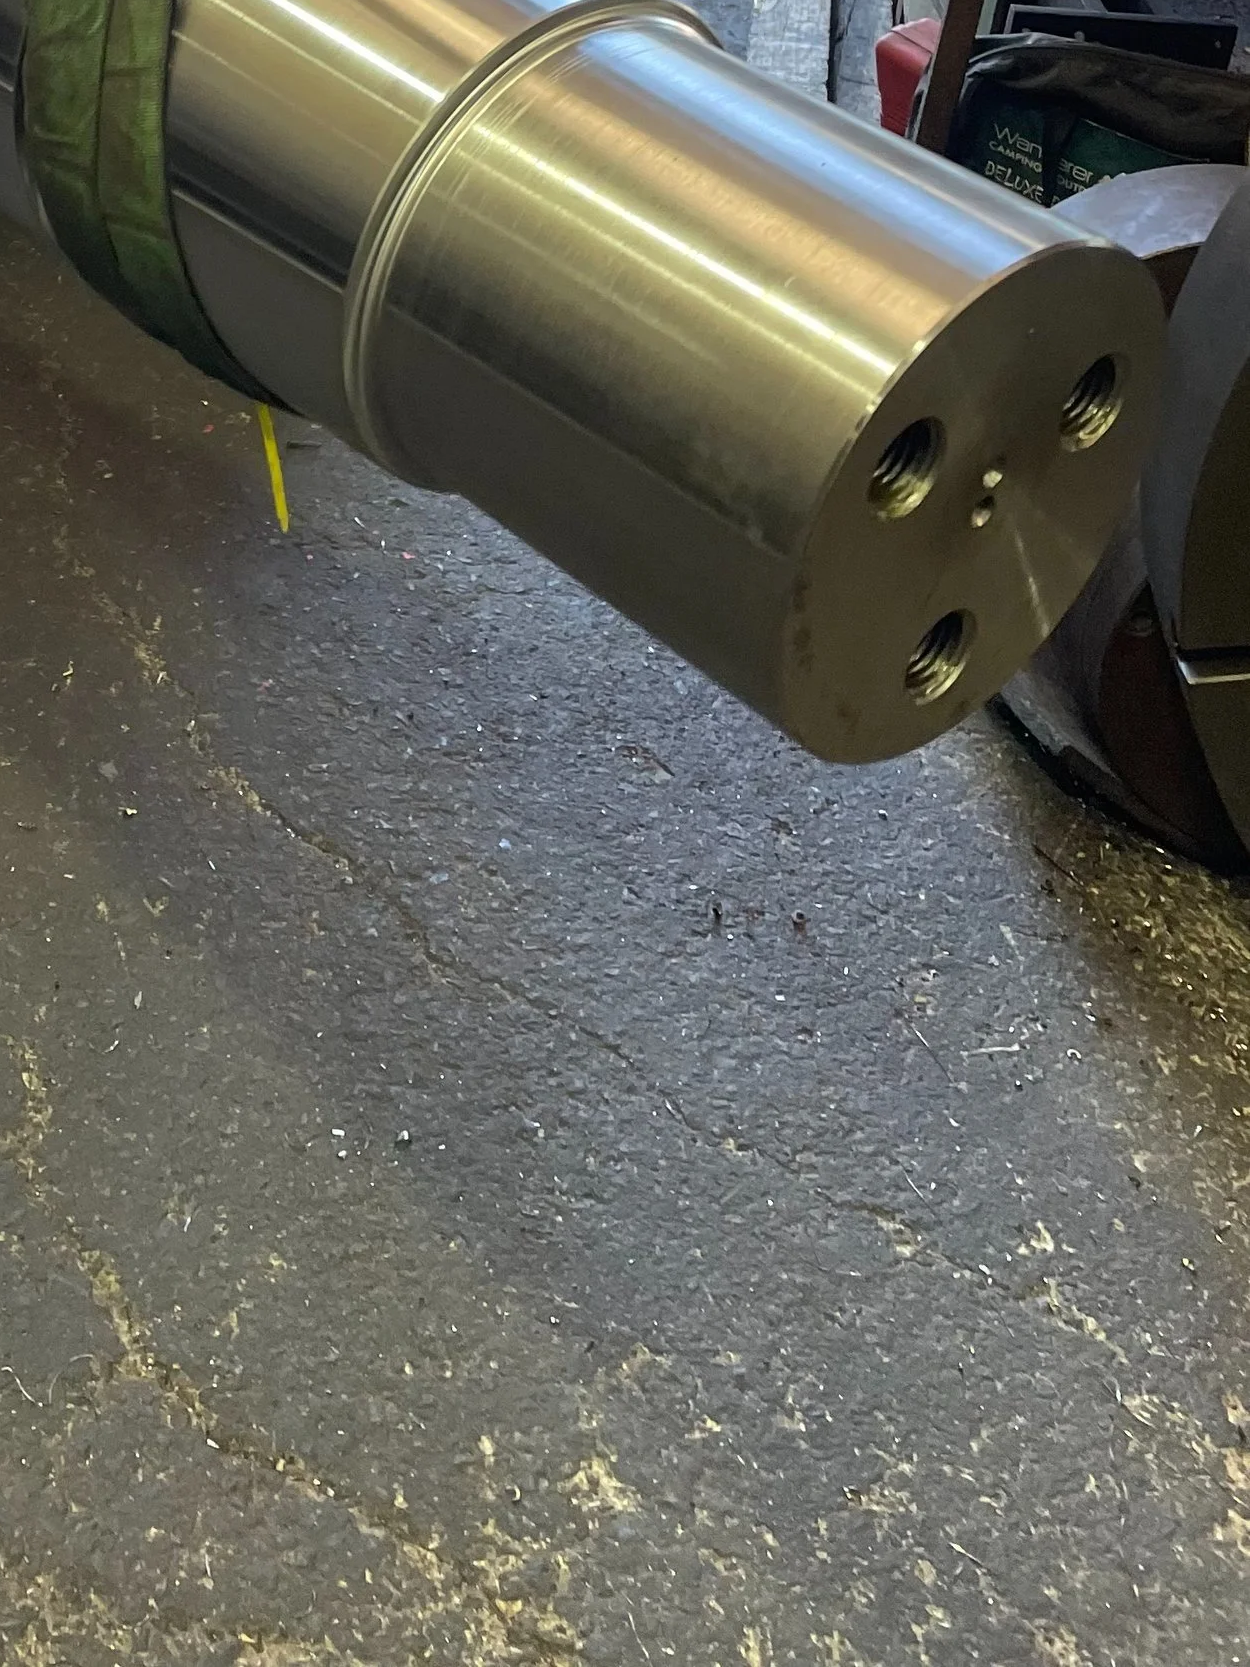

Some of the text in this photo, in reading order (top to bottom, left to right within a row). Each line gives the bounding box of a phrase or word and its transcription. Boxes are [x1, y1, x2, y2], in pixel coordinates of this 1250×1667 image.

[989, 141, 1043, 173] CAMPING
[993, 123, 1094, 184] Wanerer
[985, 160, 1044, 204] DELUXE
